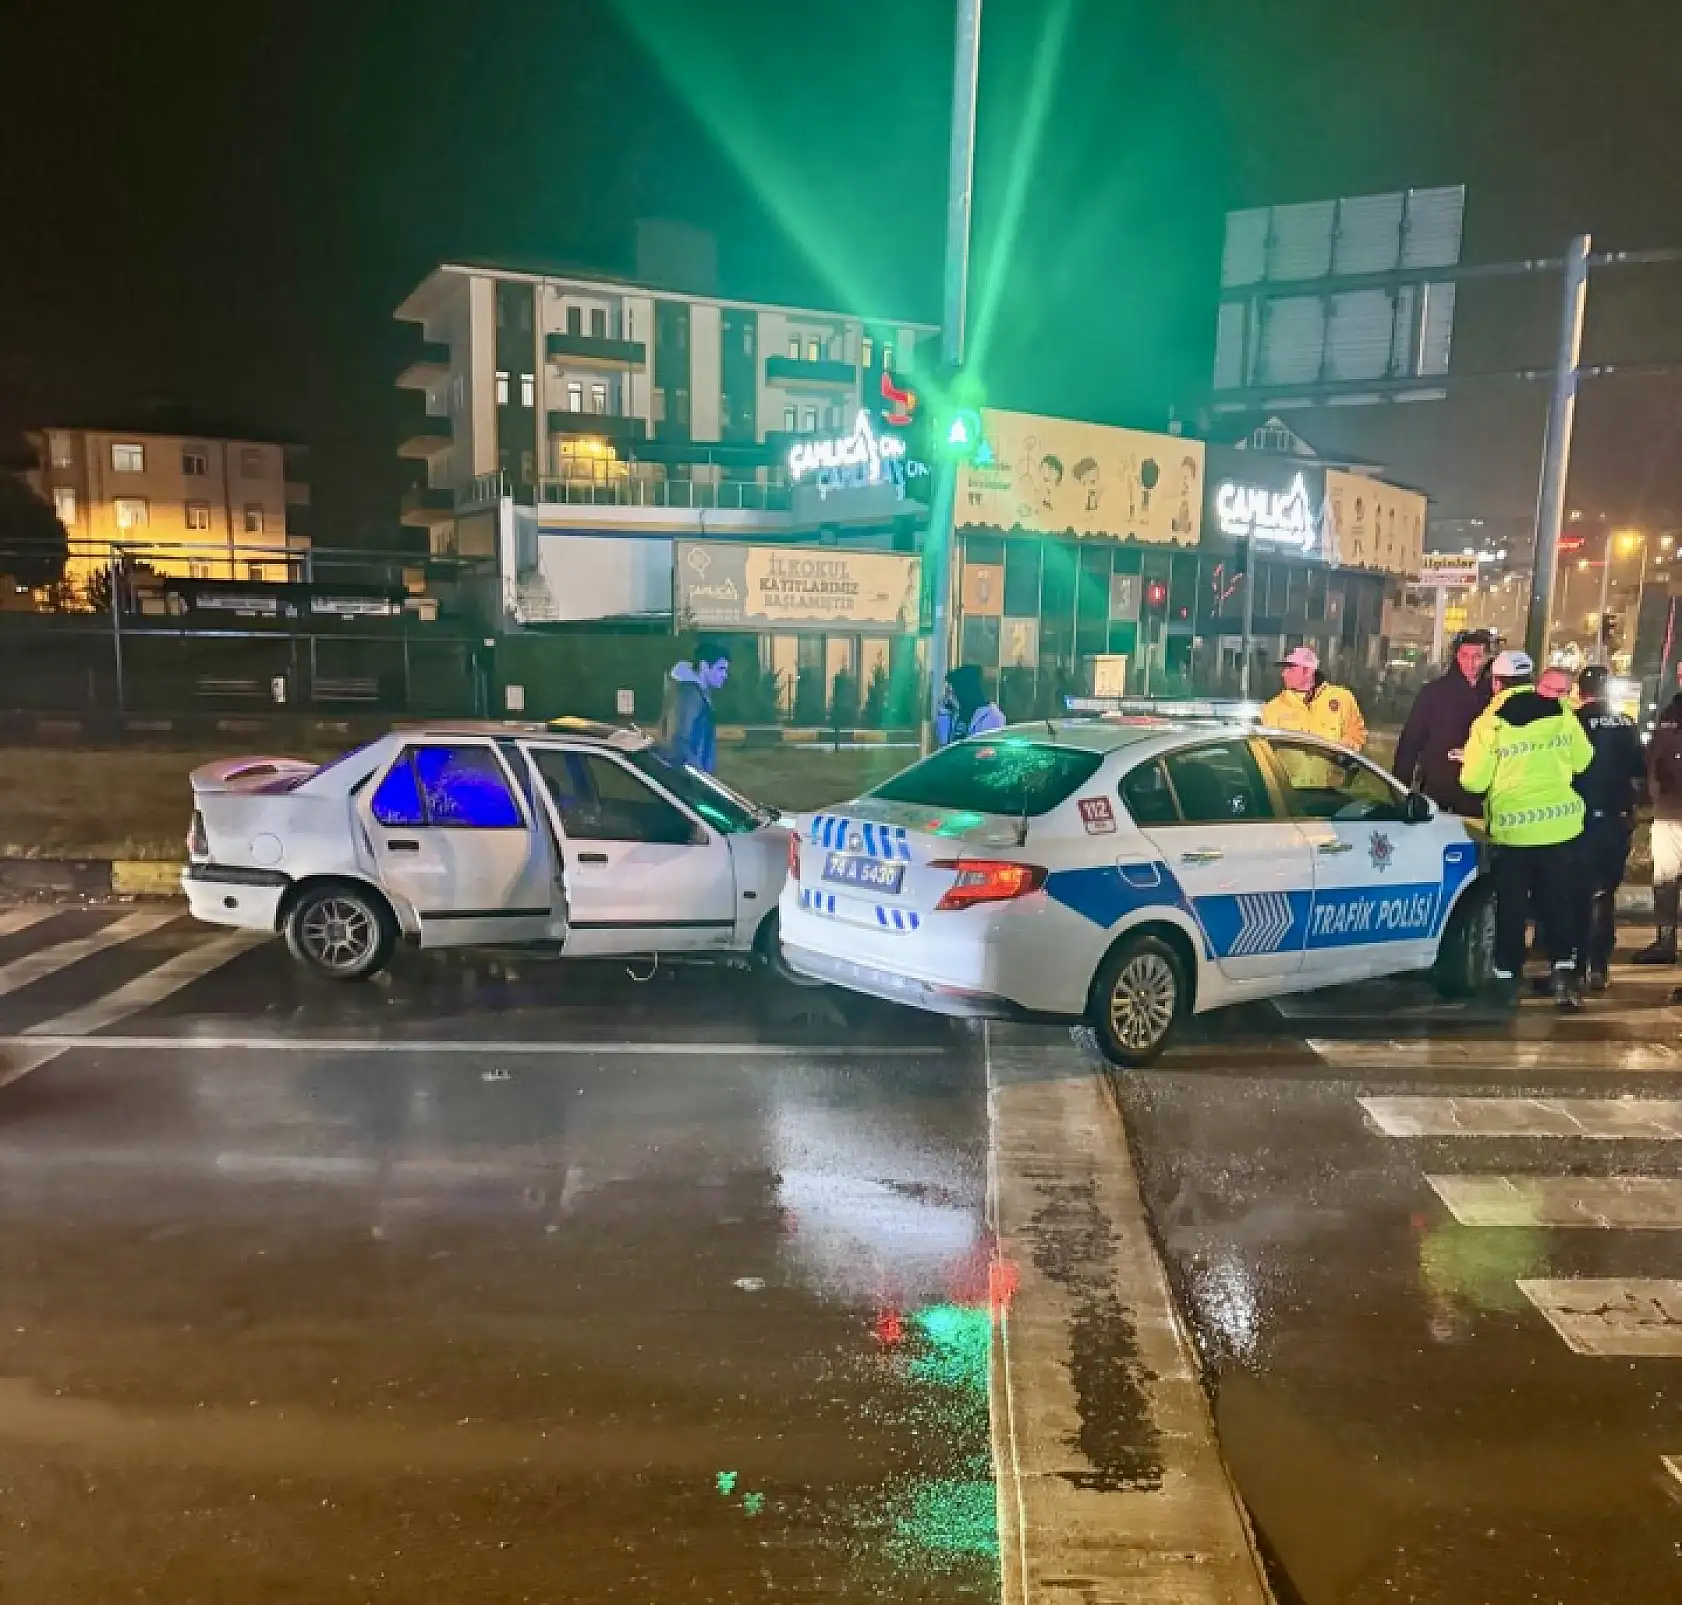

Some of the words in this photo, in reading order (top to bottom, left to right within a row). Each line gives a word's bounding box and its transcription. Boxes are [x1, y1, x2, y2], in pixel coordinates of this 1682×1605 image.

[769, 552, 851, 578] İLKOKUL
[1082, 801, 1110, 819] 112
[1312, 895, 1376, 937] TRAFİK
[1375, 892, 1433, 929] POLİSİ
